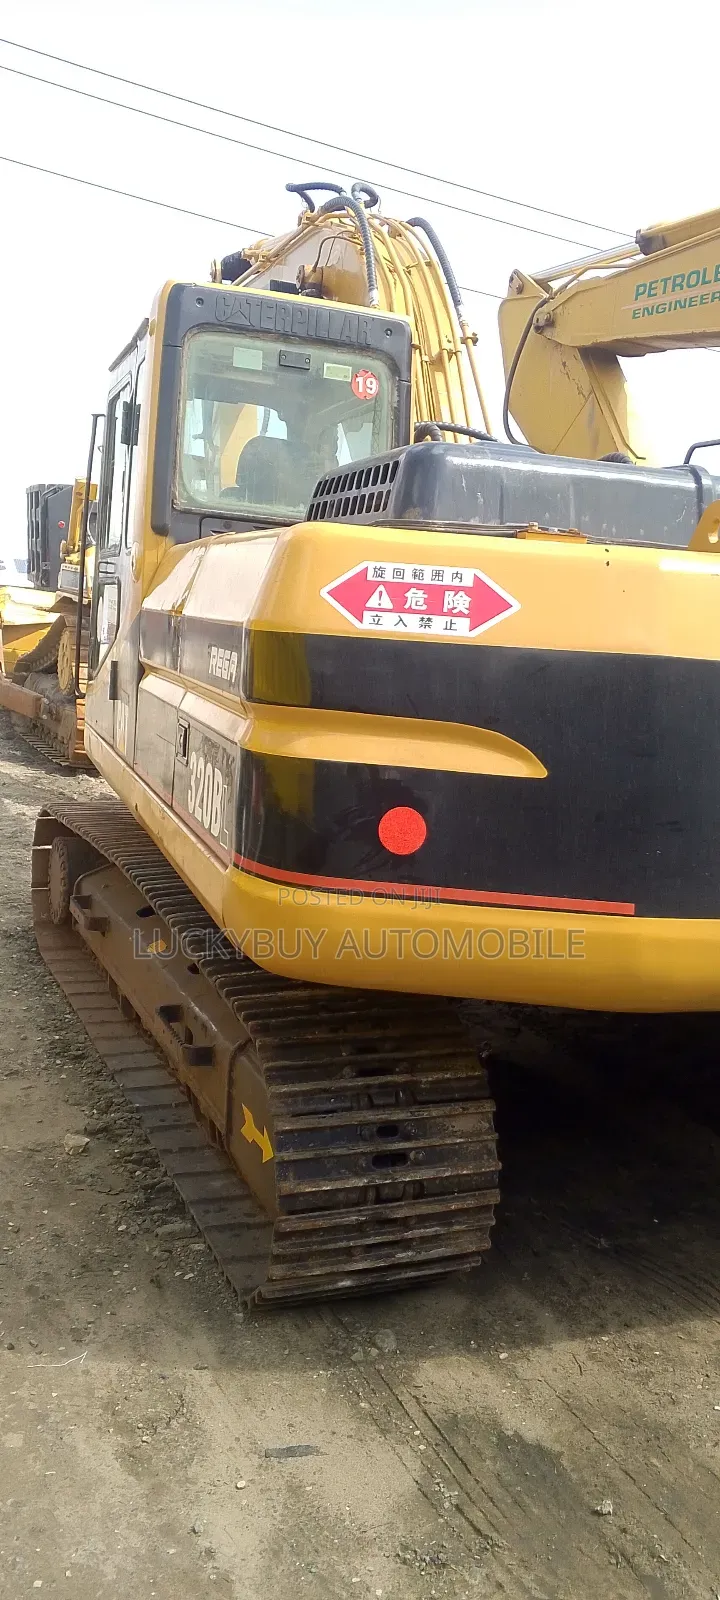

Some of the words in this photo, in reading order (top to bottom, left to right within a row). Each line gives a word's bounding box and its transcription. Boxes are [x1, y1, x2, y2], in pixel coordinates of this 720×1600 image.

[215, 294, 374, 346] CATERPILLAR
[355, 376, 378, 395] 19
[372, 565, 464, 583] 旋回範囲内
[403, 587, 473, 615] 危険
[369, 613, 458, 632] 立入禁止
[208, 646, 238, 683] REGA
